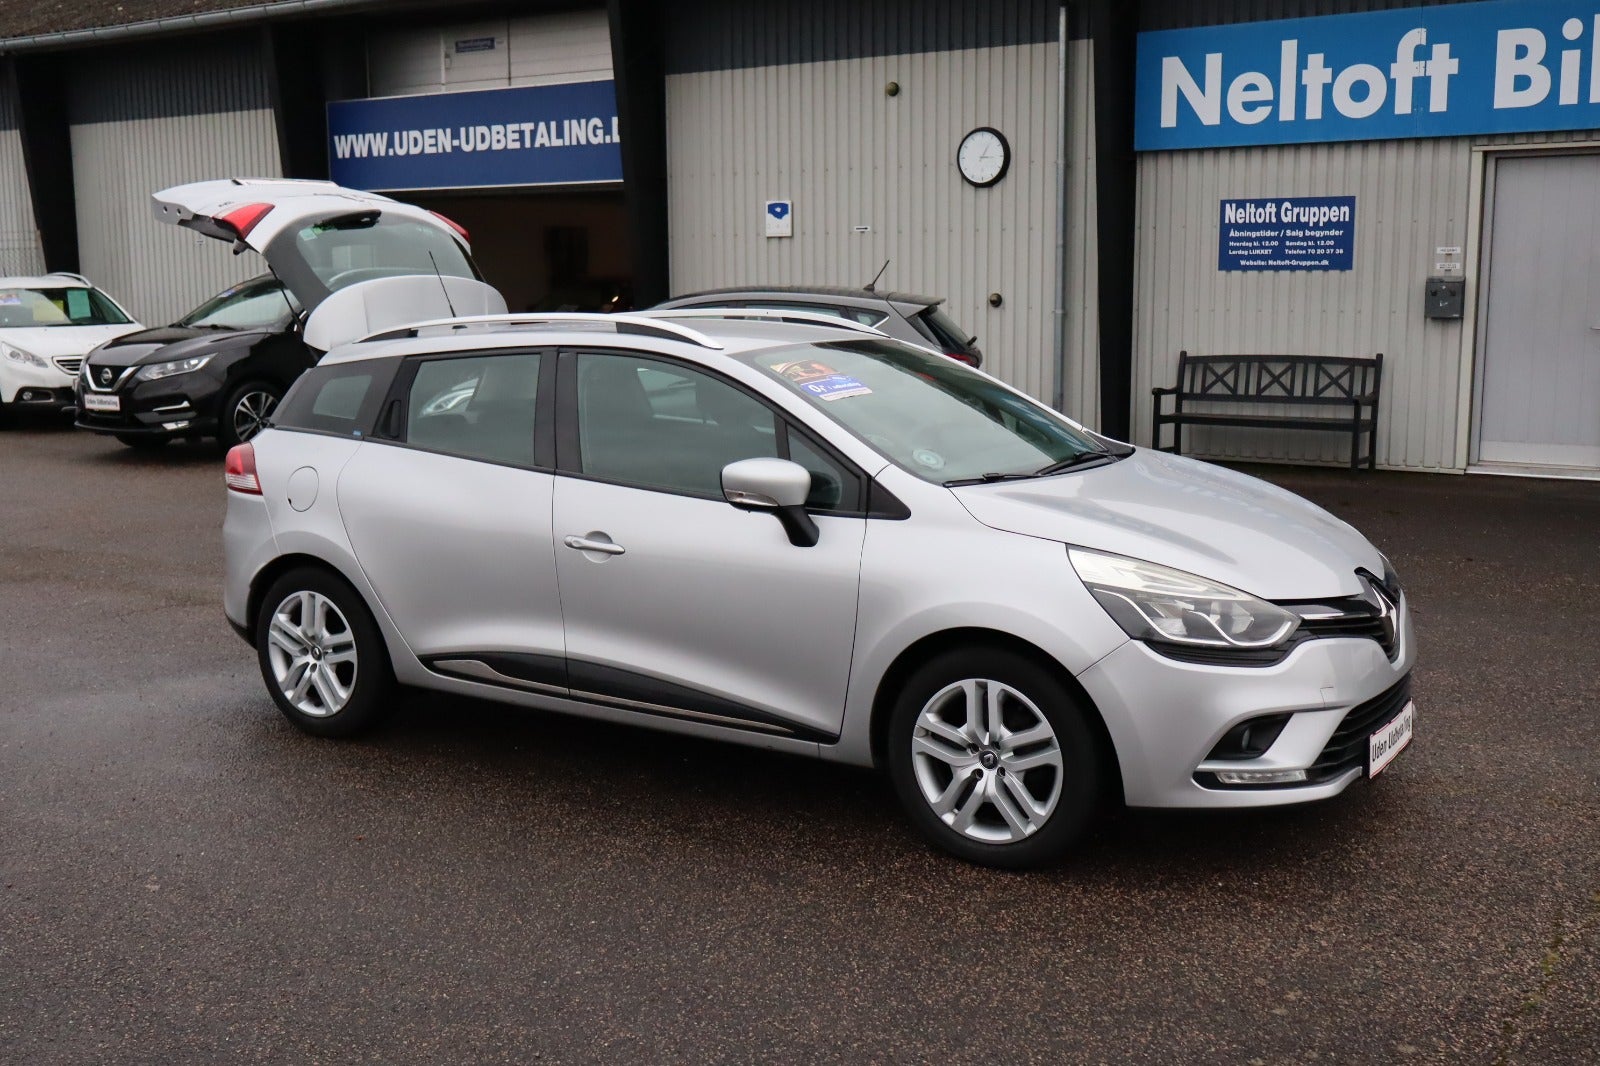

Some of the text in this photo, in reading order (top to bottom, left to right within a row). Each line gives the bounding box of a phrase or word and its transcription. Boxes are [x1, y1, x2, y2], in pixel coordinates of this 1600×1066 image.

[1161, 28, 1459, 128] Neltoft
[1224, 201, 1350, 227] Neltoft Gruppen
[1229, 228, 1279, 238] Åbningstider
[1285, 229, 1304, 238] Salg
[1305, 228, 1344, 237] begynder
[1372, 739, 1387, 762] Uden
